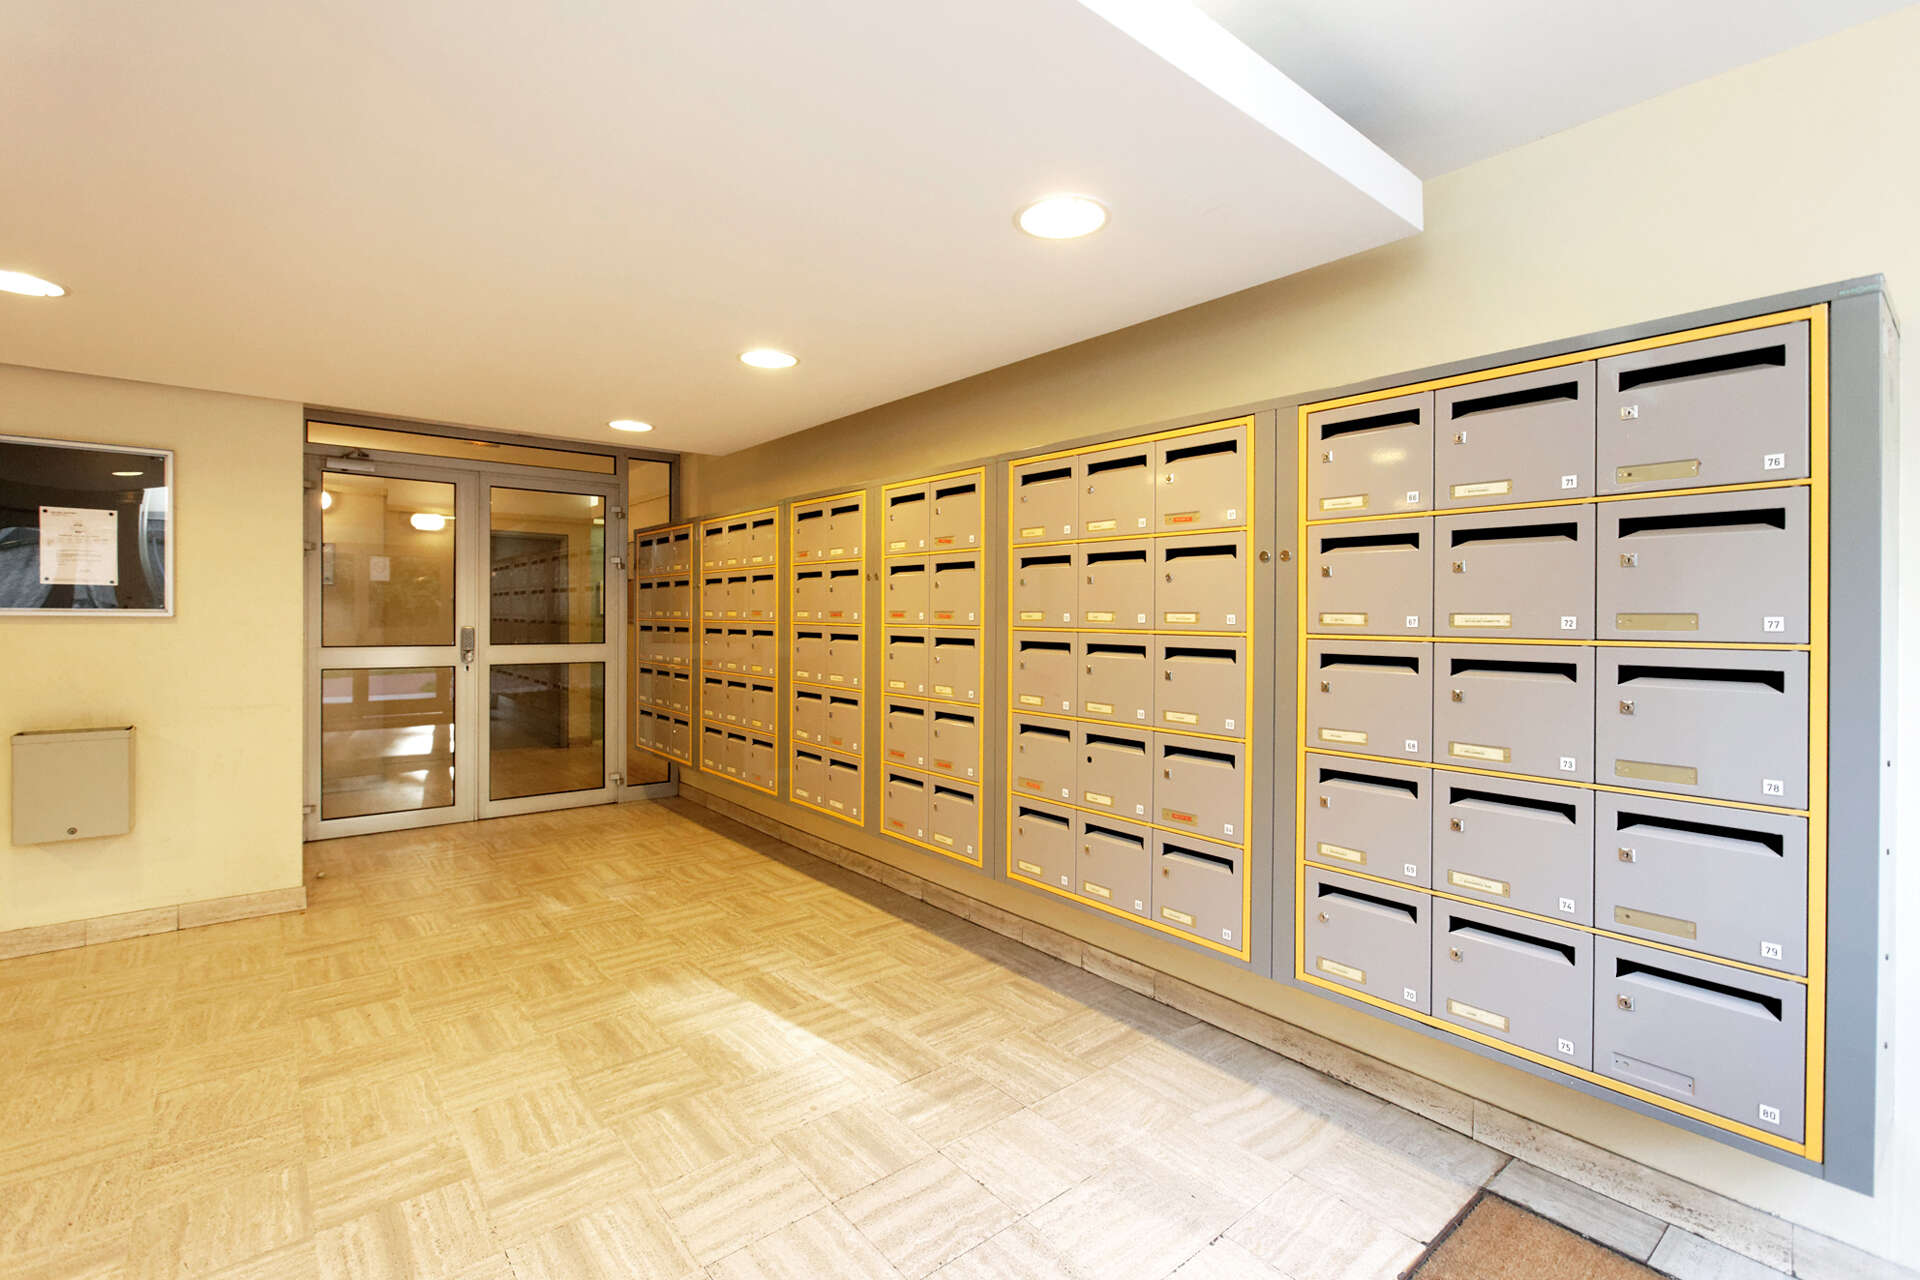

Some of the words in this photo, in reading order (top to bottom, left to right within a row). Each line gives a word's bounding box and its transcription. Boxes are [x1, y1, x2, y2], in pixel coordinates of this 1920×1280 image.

[1767, 457, 1781, 466] 76
[1767, 620, 1780, 629] 77
[1766, 783, 1780, 793] 78
[1765, 945, 1778, 957] 79
[1762, 1109, 1776, 1121] 80
